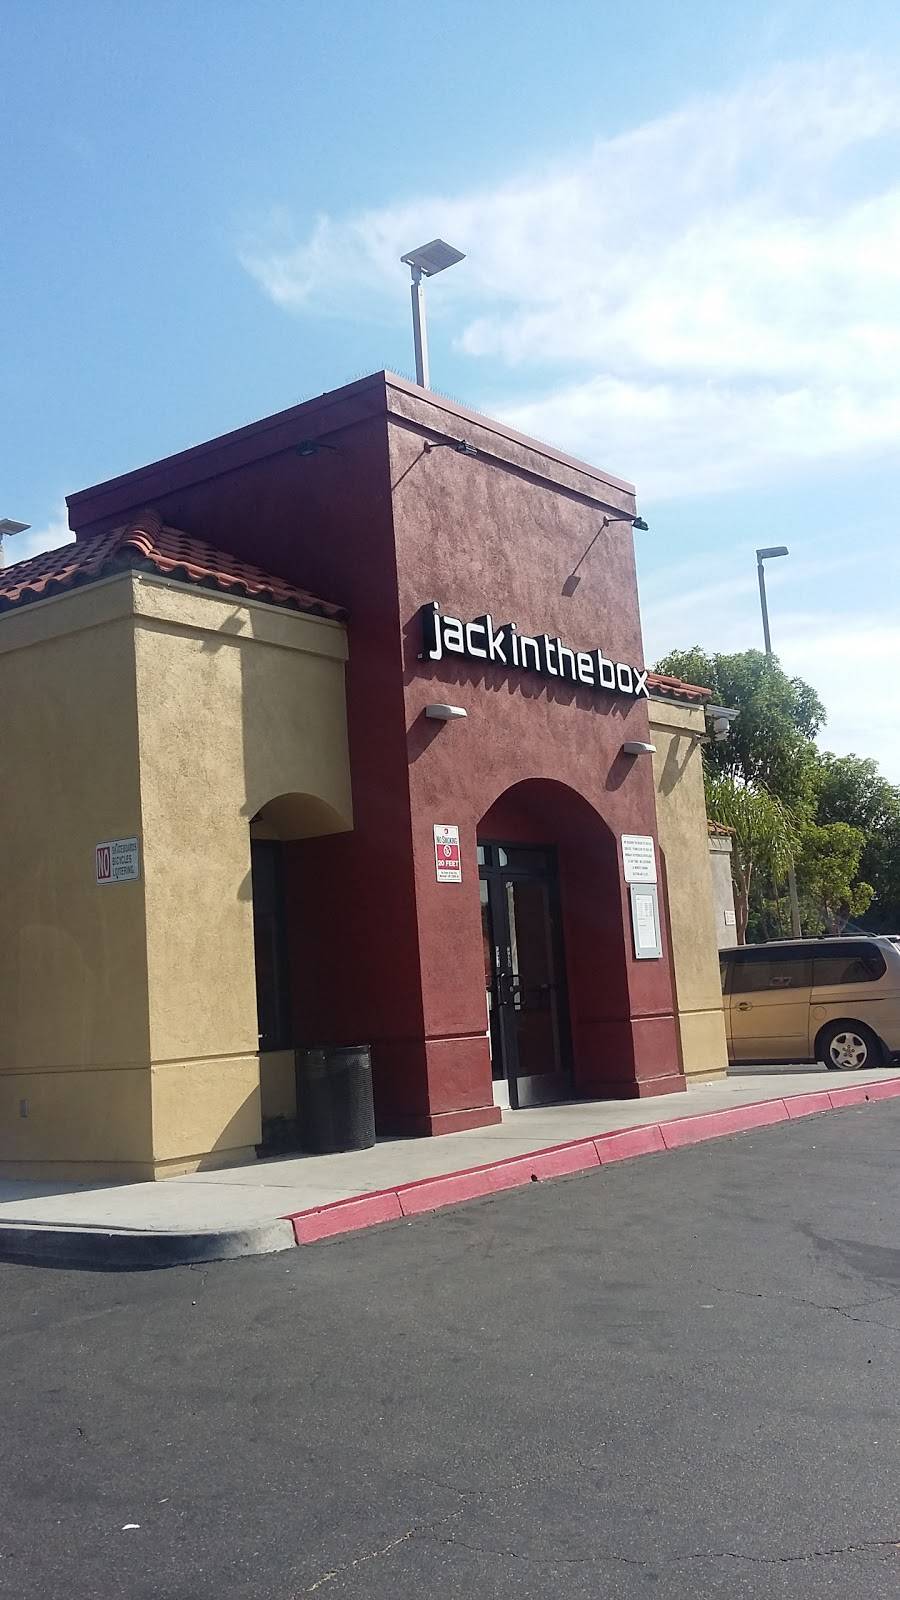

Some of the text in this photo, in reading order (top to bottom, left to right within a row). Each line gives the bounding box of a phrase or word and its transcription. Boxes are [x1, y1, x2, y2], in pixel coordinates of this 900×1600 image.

[429, 601, 651, 698] jack in the box
[97, 847, 111, 879] NO
